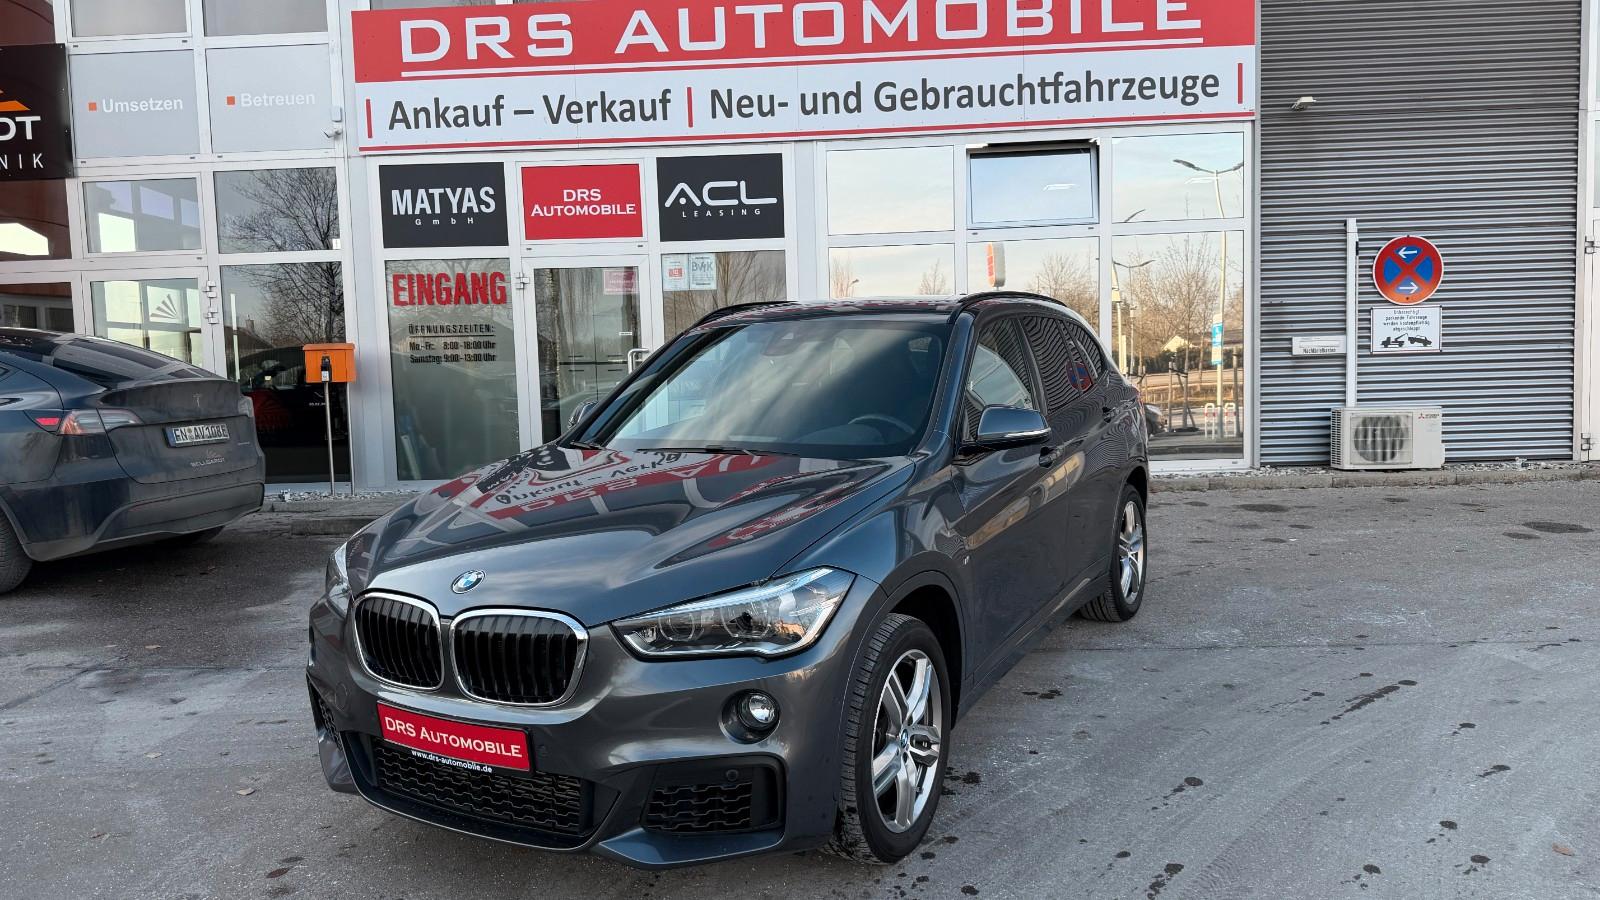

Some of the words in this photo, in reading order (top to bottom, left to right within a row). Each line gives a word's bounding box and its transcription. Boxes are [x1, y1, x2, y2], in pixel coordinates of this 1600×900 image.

[401, 13, 575, 63] DRS
[614, 0, 1203, 55] AUTOMOBILE
[102, 97, 183, 113] Umsetzen
[240, 93, 316, 107] Betreuen
[388, 94, 505, 131] Ankauf
[542, 88, 672, 125] Verkauf
[710, 88, 789, 119] Neu-
[800, 80, 862, 116] und
[873, 70, 1220, 113] Gebrauchtfahrzeuge
[391, 186, 496, 216] MATYAS
[563, 188, 602, 202] DRS
[664, 180, 778, 209] ACL
[530, 203, 637, 217] AUTOMOBILE
[682, 208, 761, 218] LEASING
[392, 271, 507, 306] EINGANG
[408, 323, 496, 335] ÖFFNUNGSZEITEN:
[482, 340, 496, 349] Uhr
[482, 353, 496, 362] Uhr
[384, 716, 417, 738] DRS
[420, 727, 522, 758] AUTOMOBILE
[411, 750, 493, 774] www.drs-automobile.de
